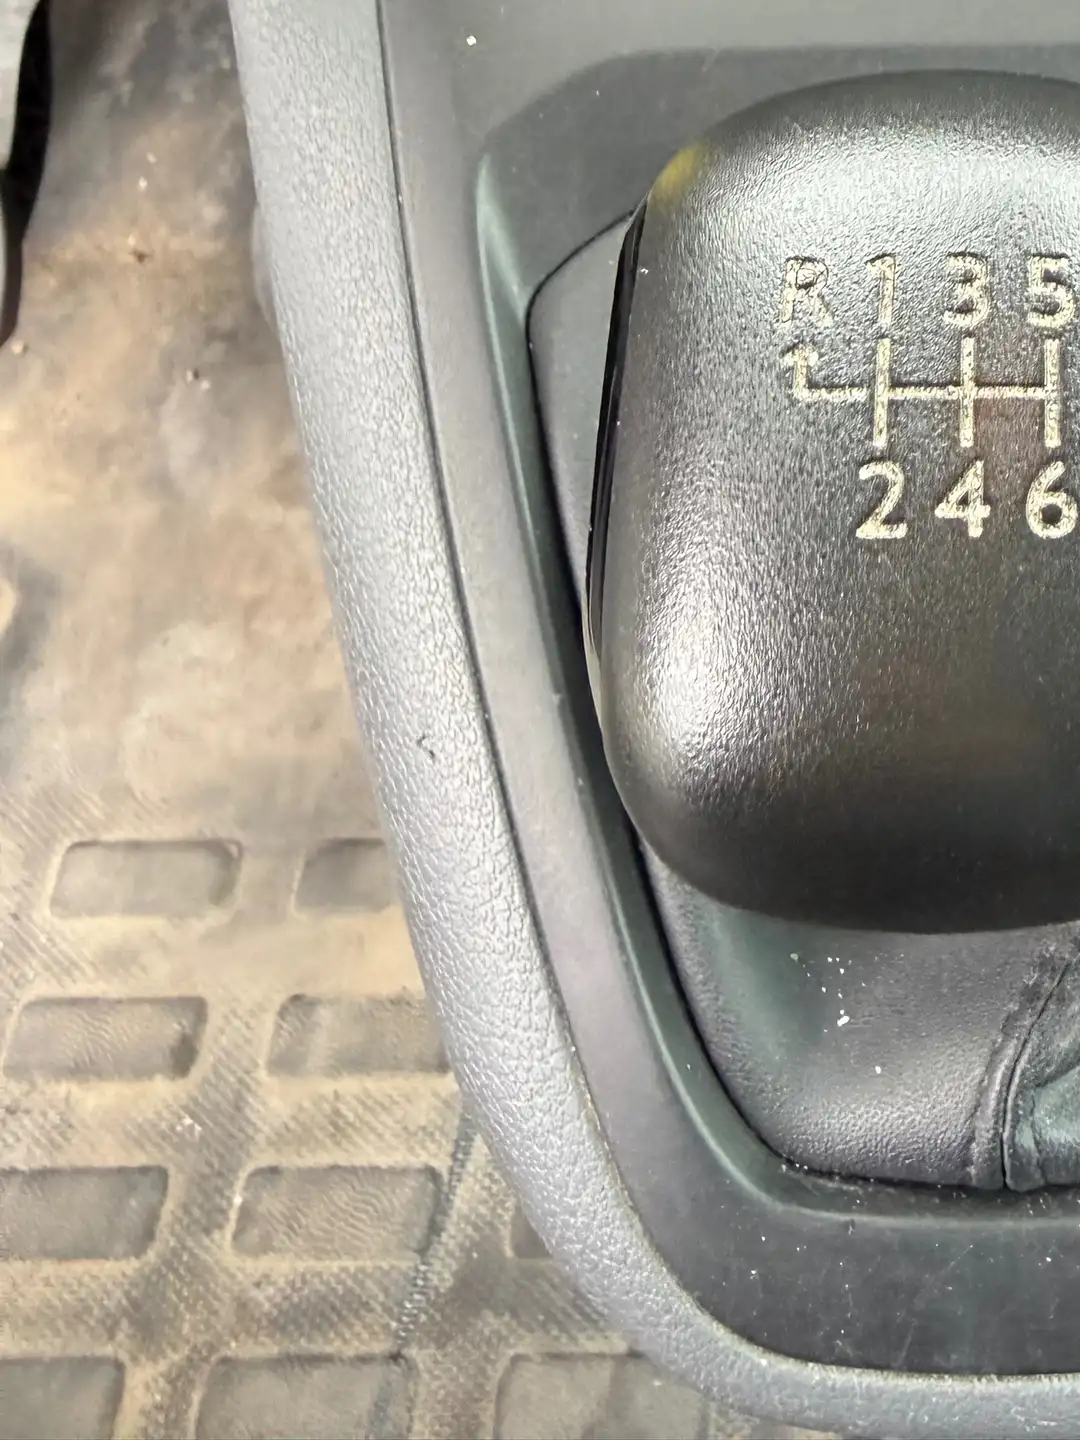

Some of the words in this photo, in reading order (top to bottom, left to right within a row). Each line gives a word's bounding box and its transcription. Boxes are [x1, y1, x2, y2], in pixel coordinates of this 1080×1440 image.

[774, 257, 832, 331] R
[865, 255, 896, 327] 1
[942, 254, 990, 328] 3
[1027, 255, 1076, 329] 5
[856, 460, 908, 539] 2
[934, 460, 991, 538] 4
[1026, 460, 1079, 539] 6
